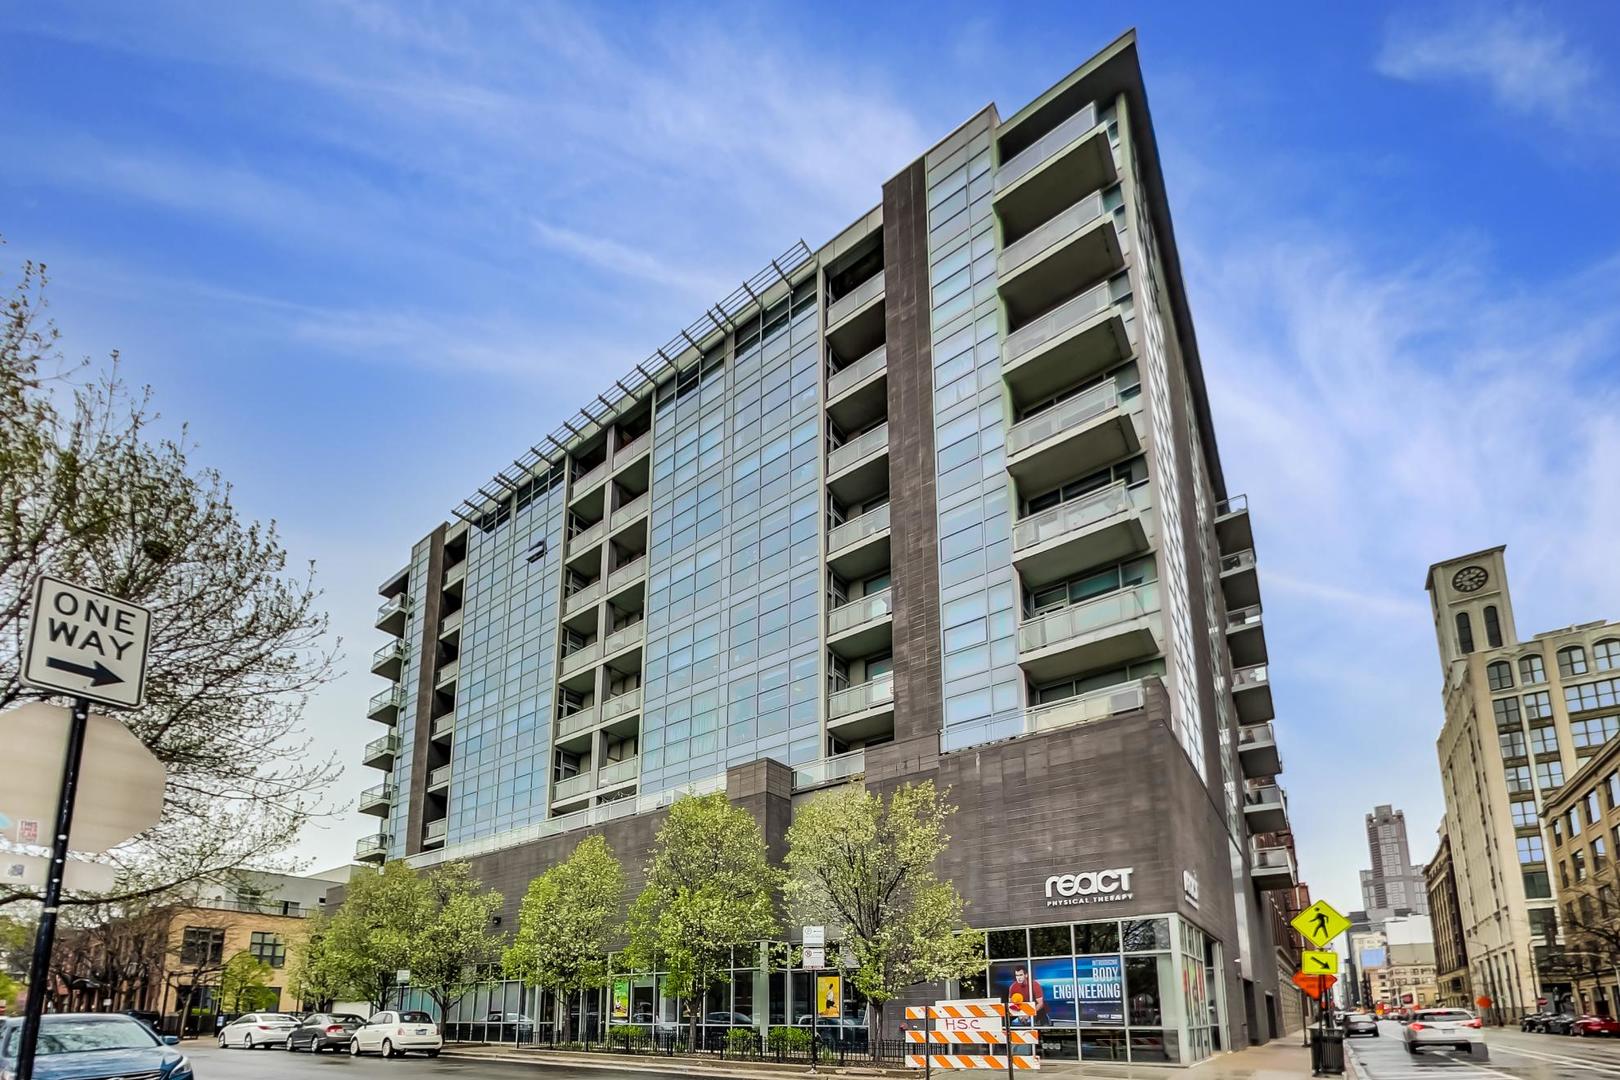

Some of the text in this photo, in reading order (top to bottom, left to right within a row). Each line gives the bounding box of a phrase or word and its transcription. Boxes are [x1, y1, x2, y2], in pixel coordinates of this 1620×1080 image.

[54, 591, 136, 635] ONE
[48, 617, 134, 661] WAY
[1046, 892, 1134, 907] PHYSICAL THERAPY
[1092, 966, 1119, 982] BODY
[1053, 982, 1121, 1000] ENGINEERING
